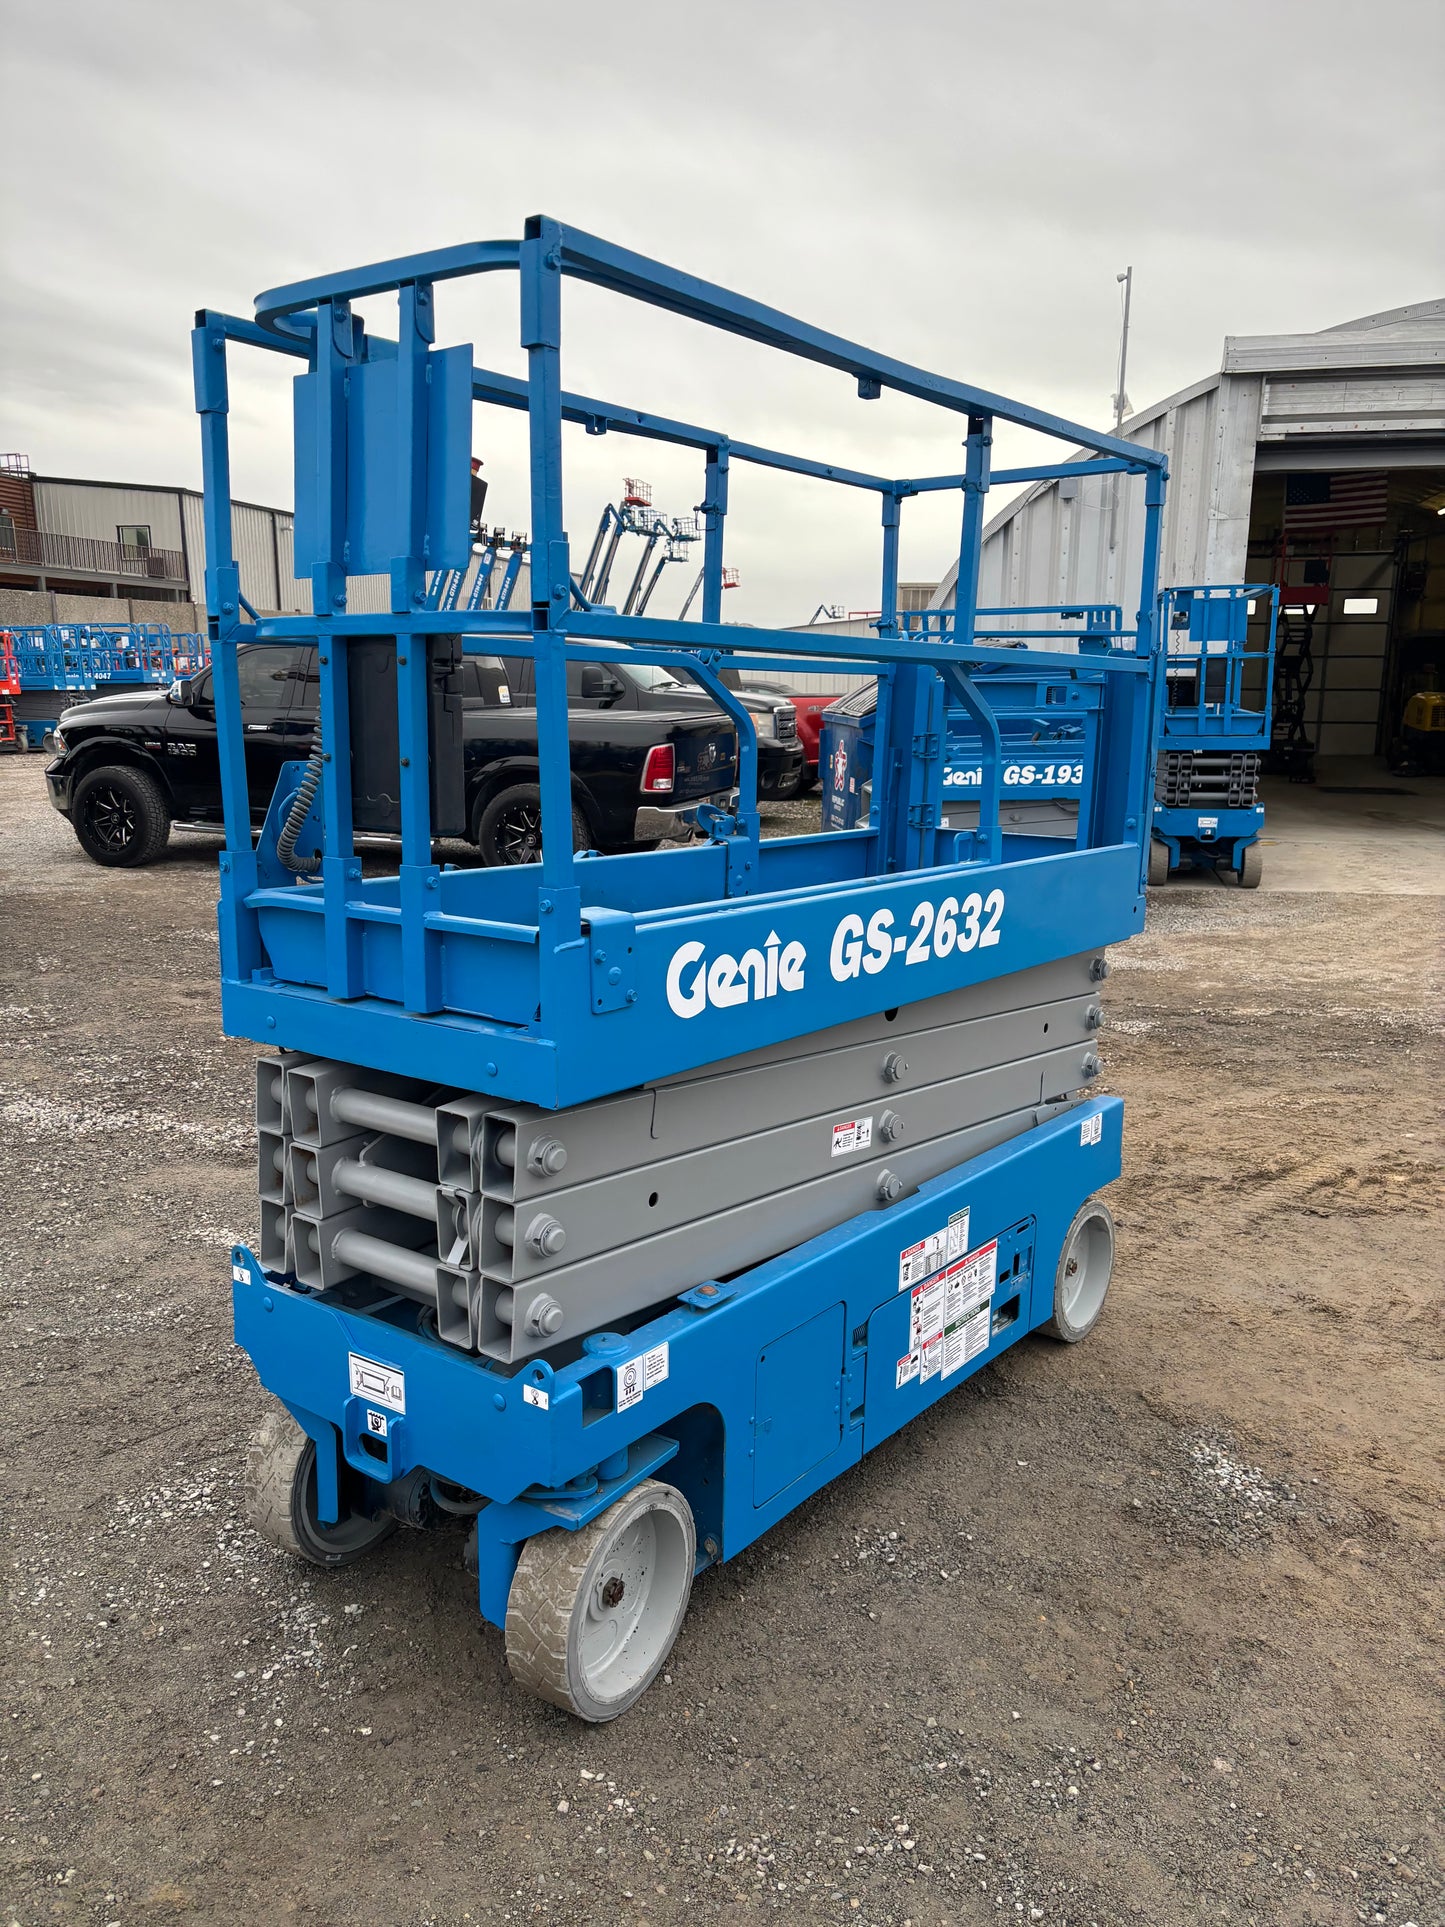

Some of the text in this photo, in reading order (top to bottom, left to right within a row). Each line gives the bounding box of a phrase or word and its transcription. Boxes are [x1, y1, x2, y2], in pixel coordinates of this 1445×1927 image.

[943, 764, 1083, 786] Geni GS-193
[666, 888, 1005, 1019] Genie GS-2632
